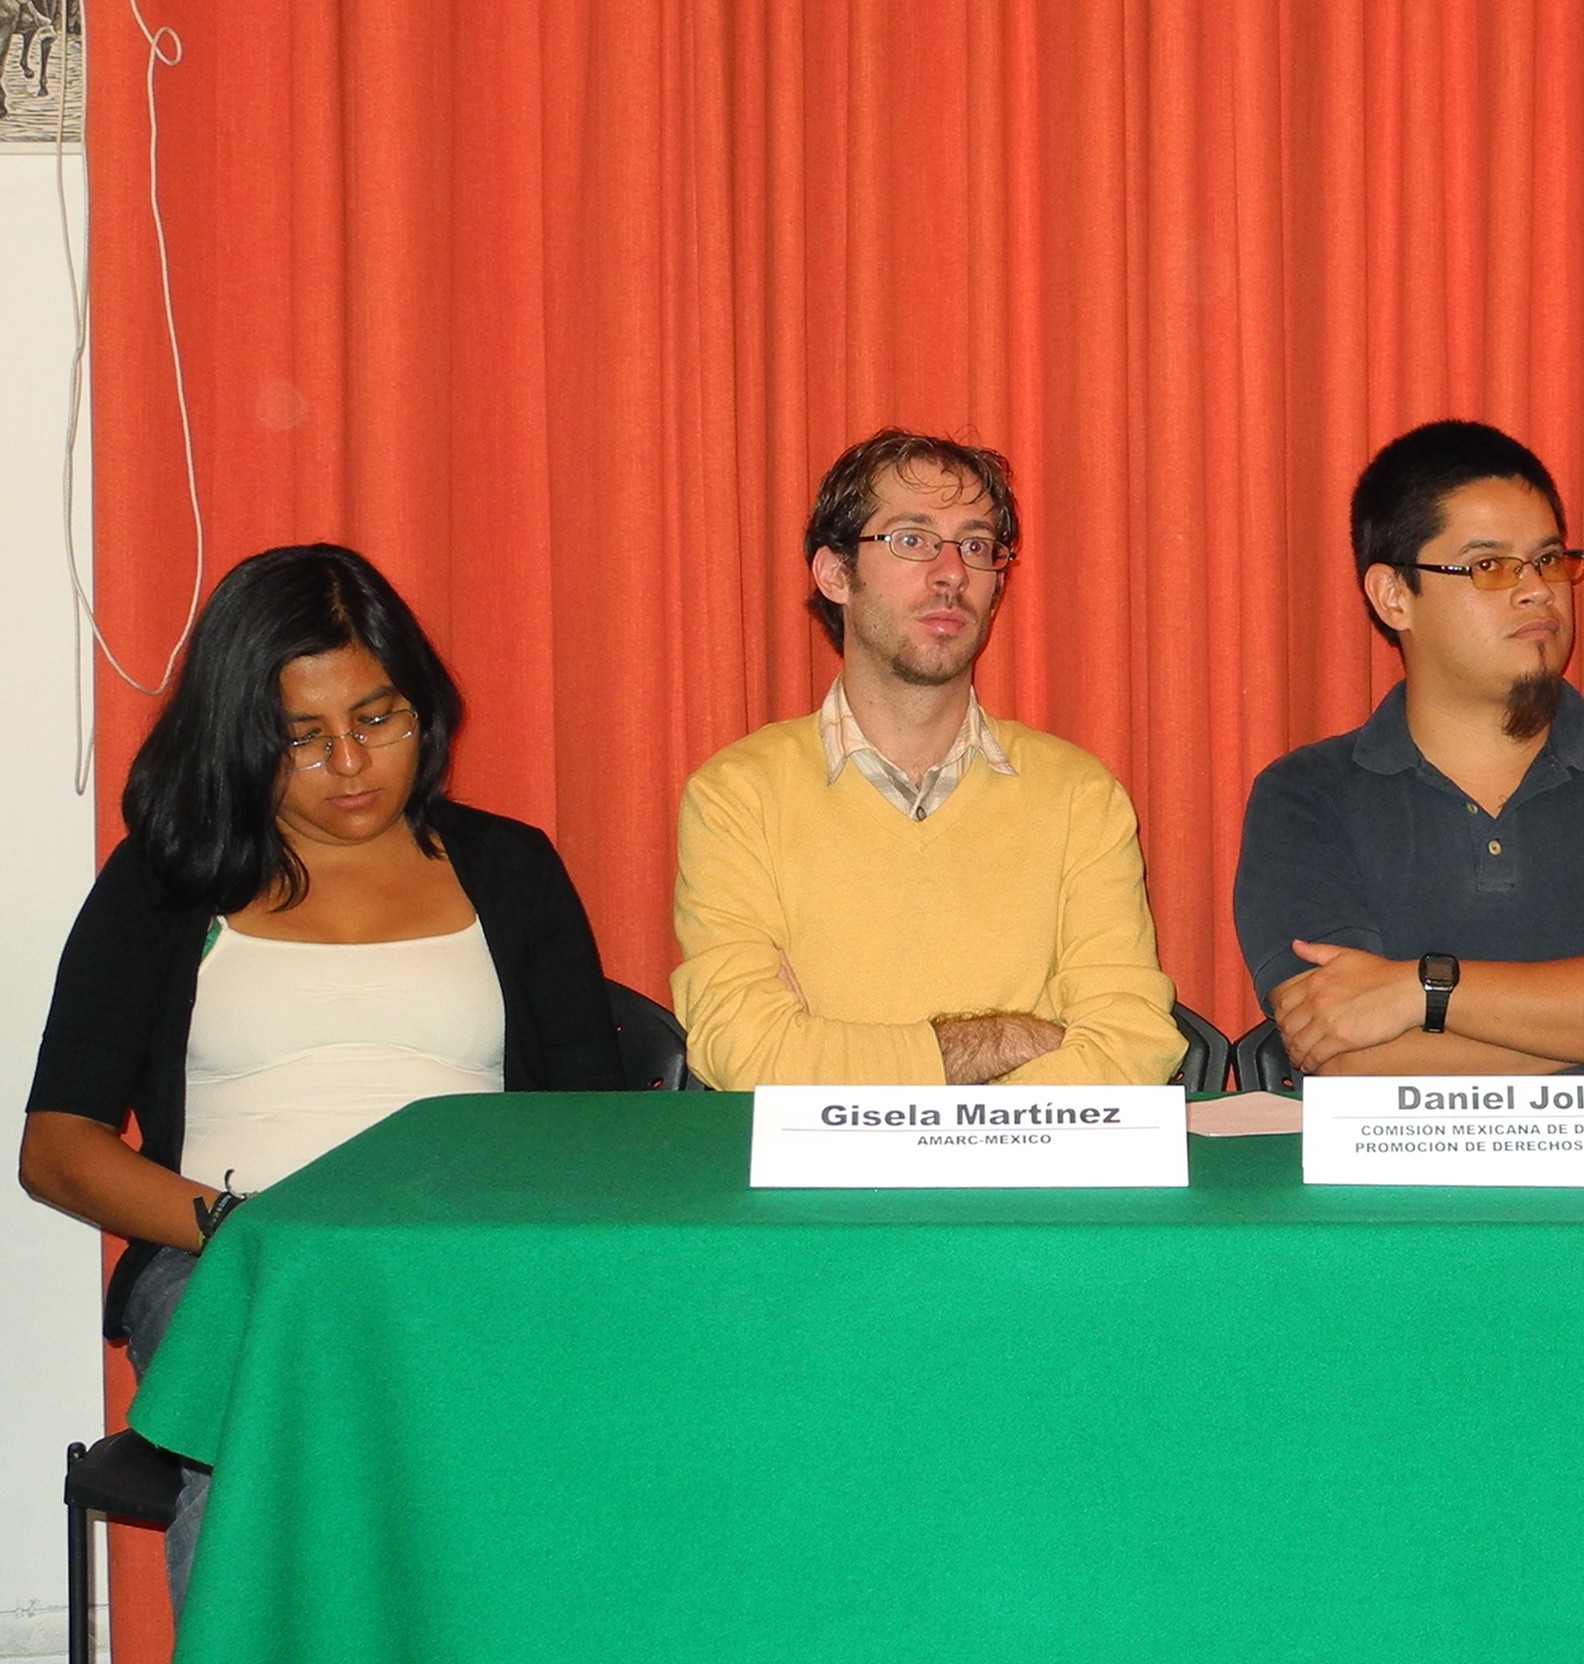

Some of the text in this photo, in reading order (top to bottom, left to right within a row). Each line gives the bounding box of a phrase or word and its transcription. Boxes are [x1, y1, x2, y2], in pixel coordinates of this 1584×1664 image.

[1397, 1085, 1515, 1111] Daniel
[820, 1101, 1122, 1127] Gisela Martínez
[1452, 1124, 1541, 1136] MEXICANA
[1546, 1123, 1568, 1135] DE
[1464, 1141, 1486, 1152] DE
[1492, 1140, 1584, 1152] DERECHOS
